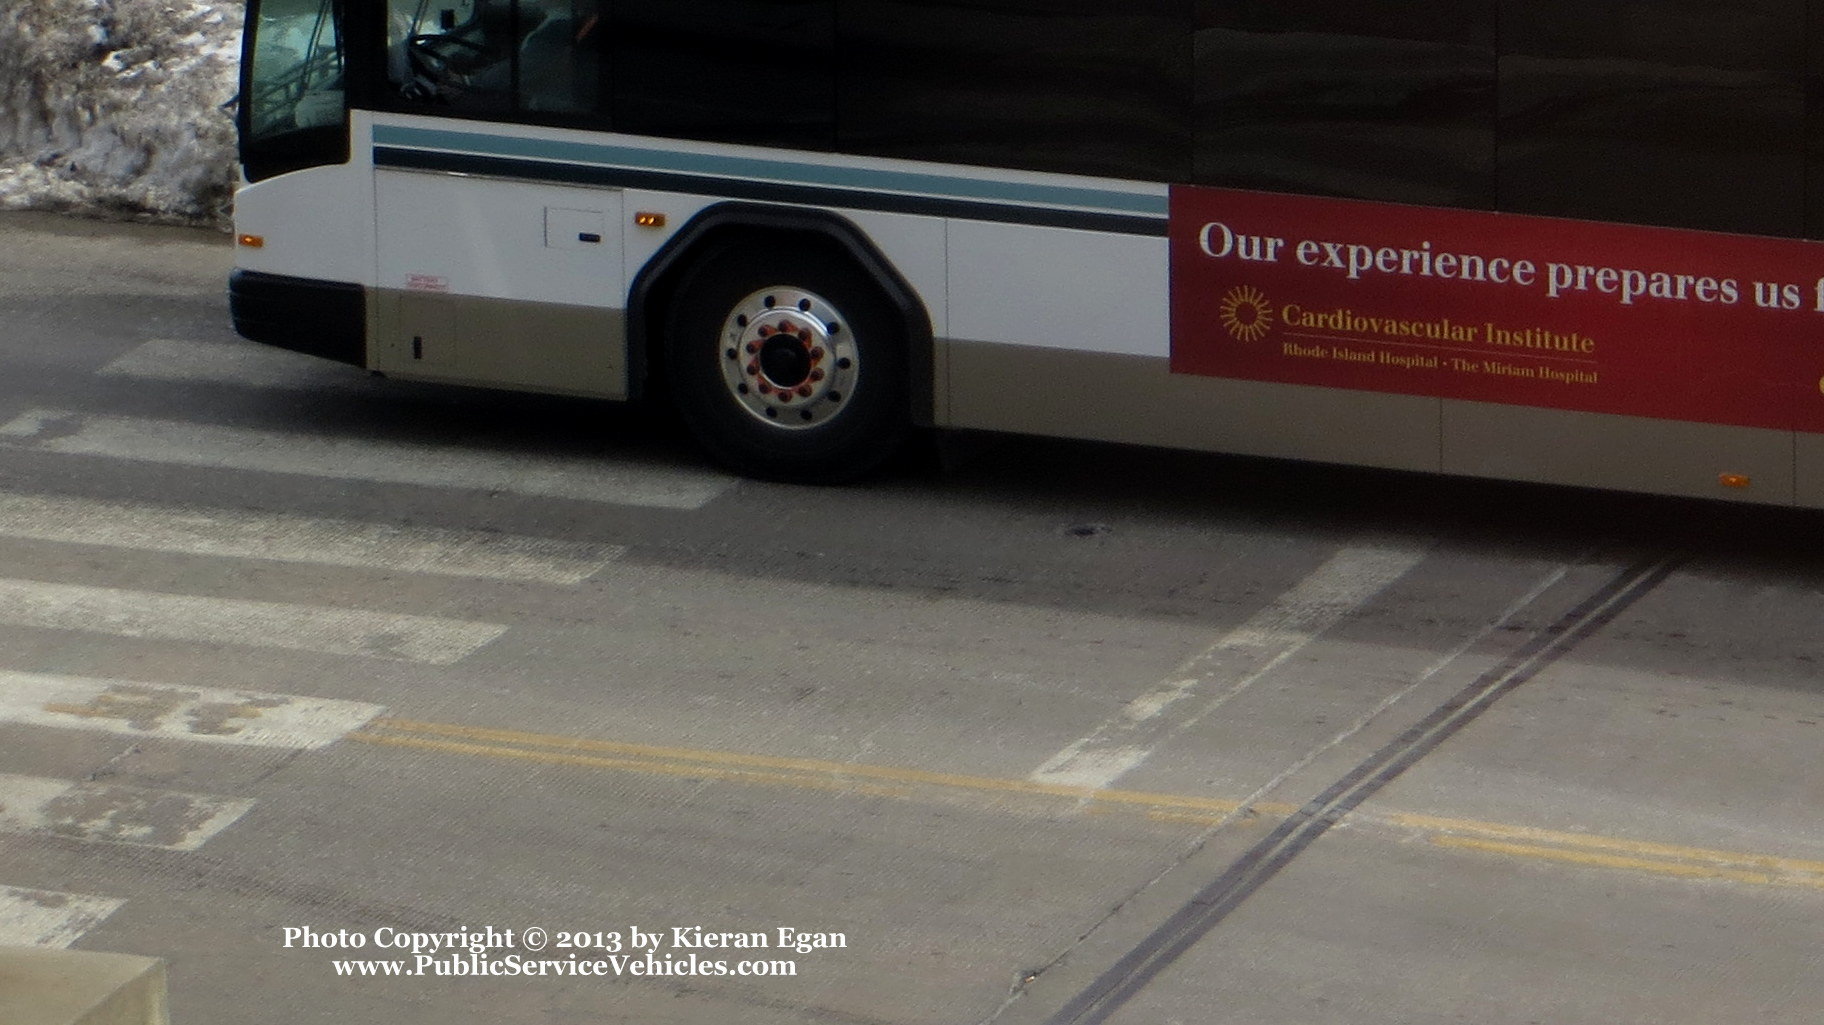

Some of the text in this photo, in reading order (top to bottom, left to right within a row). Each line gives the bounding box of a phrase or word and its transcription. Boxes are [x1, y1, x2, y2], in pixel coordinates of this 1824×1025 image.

[1199, 221, 1284, 263] Our
[1296, 240, 1536, 287] experience
[1546, 261, 1739, 306] prepares
[1753, 280, 1801, 310] us
[1281, 303, 1595, 354] Cardiovascular Institute
[1282, 341, 1599, 385] Rhode Island Hospital The Miriam Hospital
